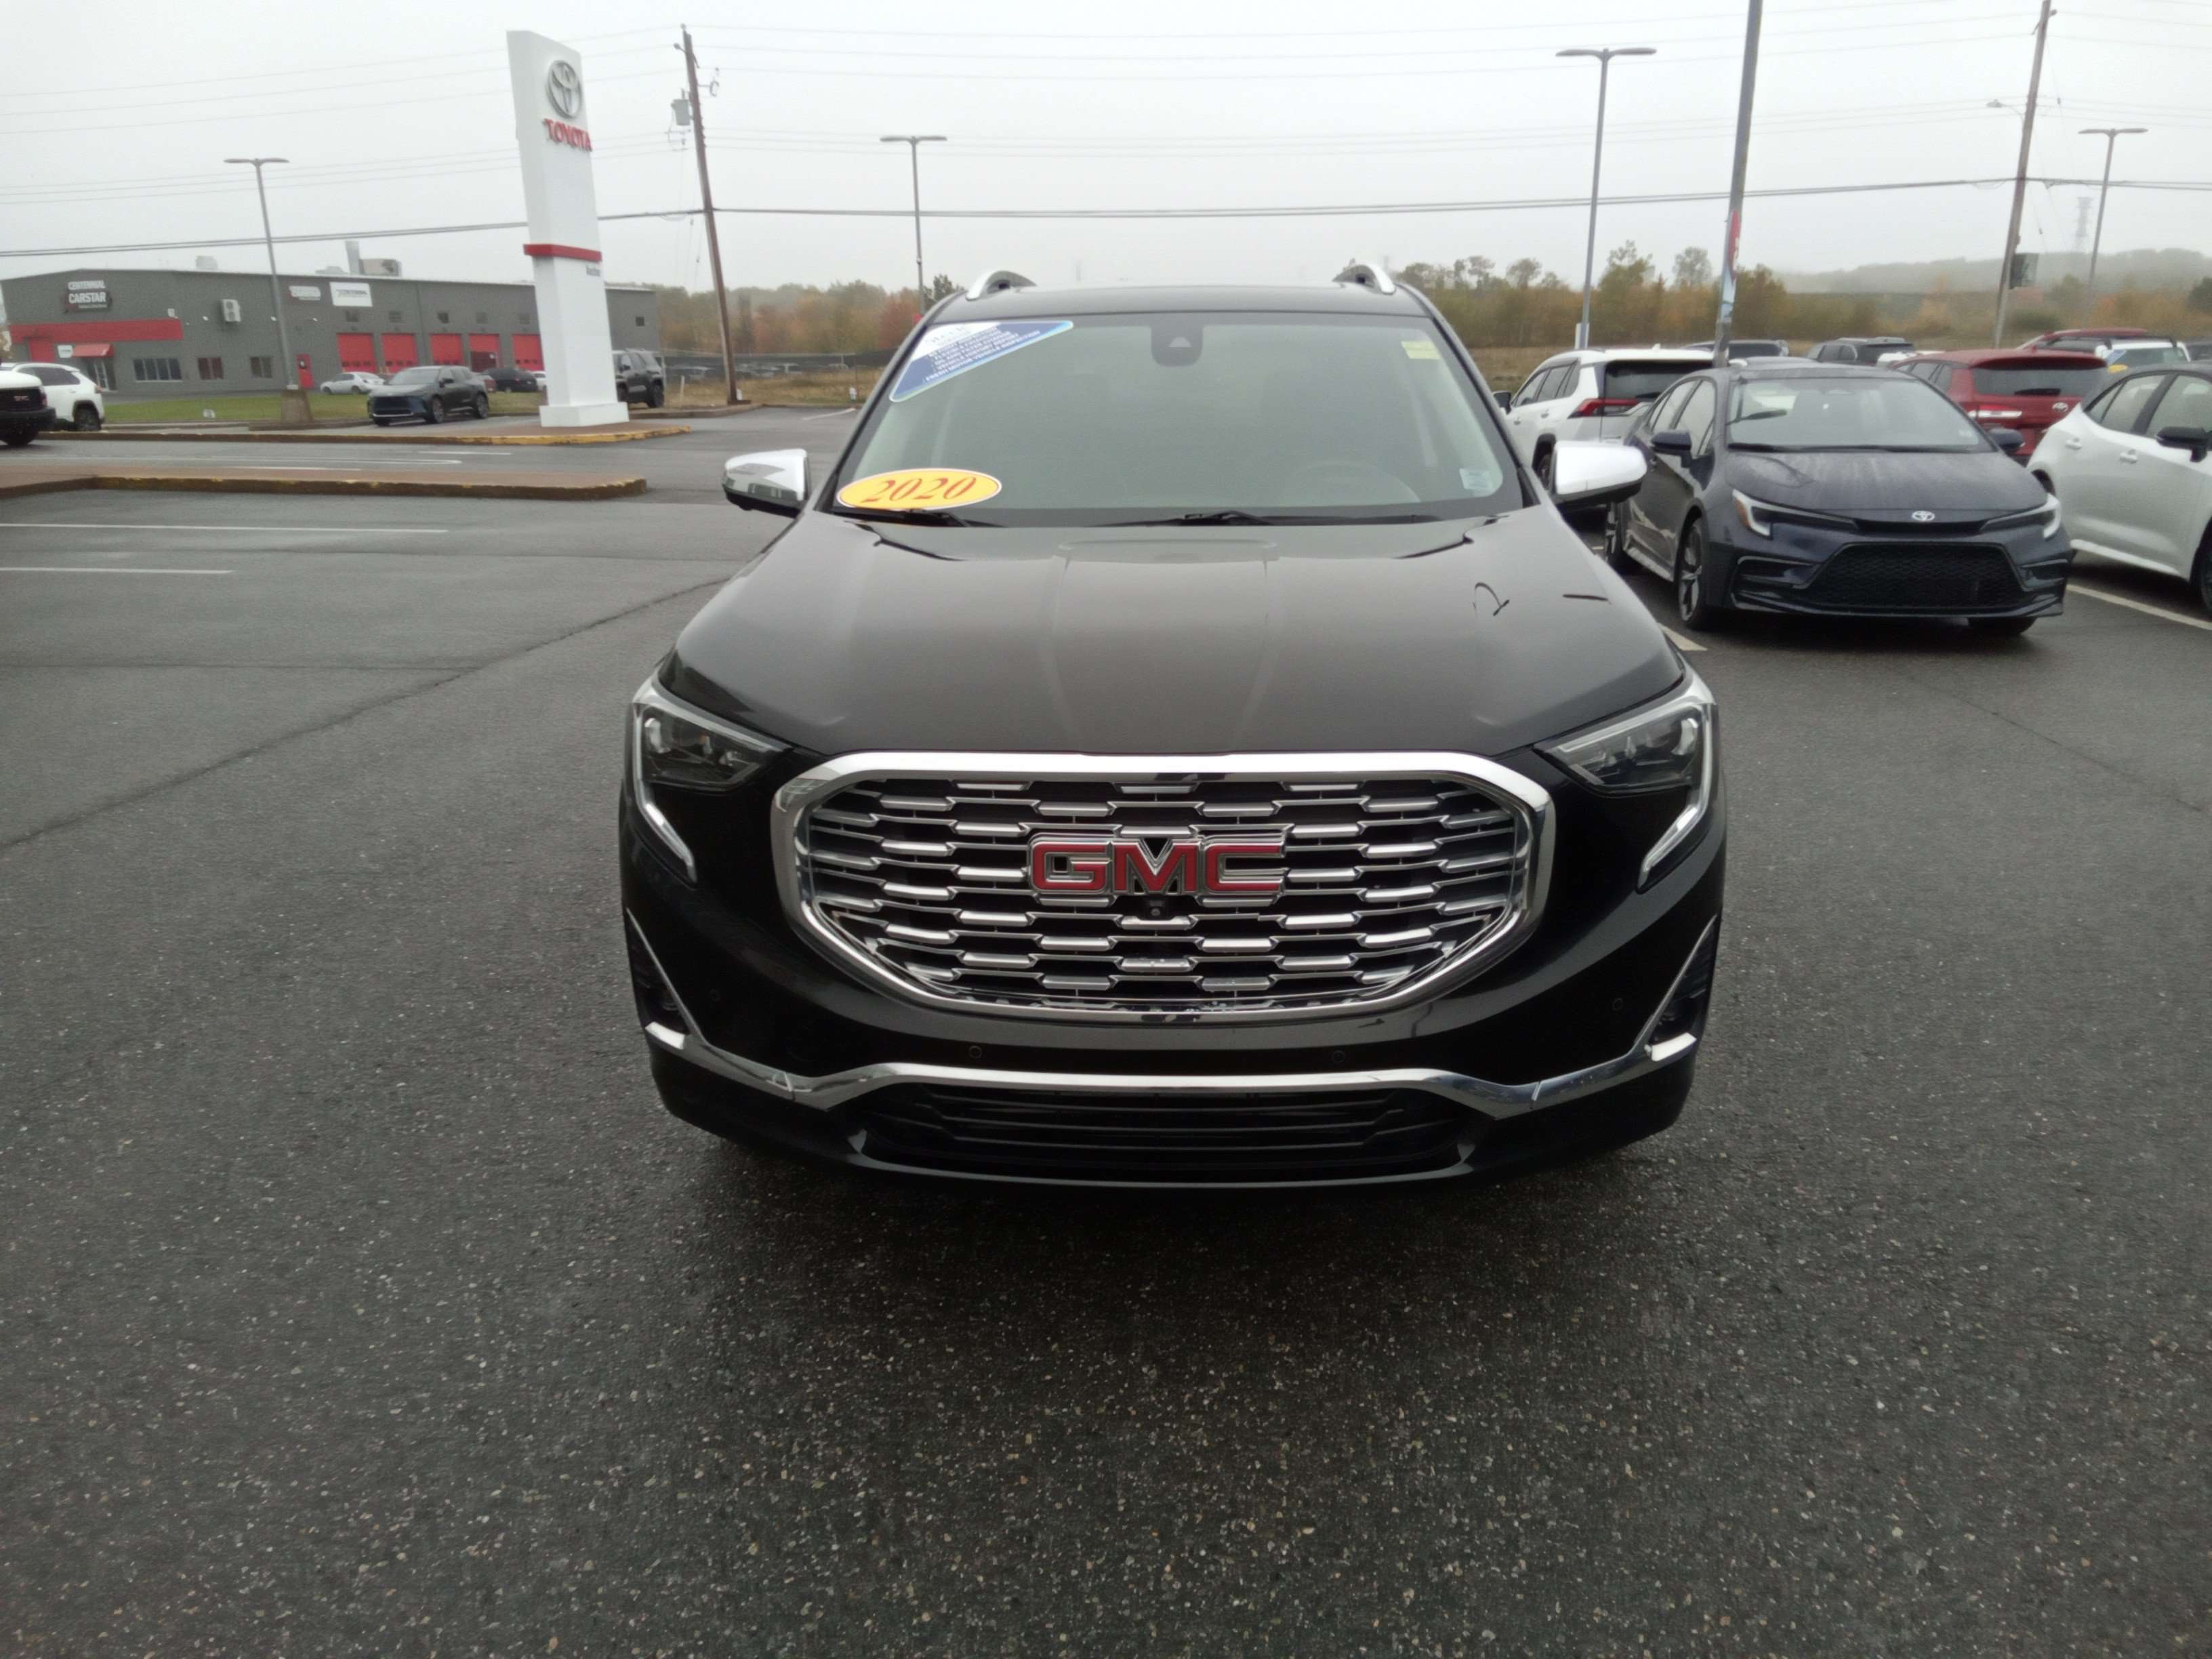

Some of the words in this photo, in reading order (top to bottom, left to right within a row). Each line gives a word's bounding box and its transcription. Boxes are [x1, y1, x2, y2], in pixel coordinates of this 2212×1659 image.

[543, 119, 592, 151] TOYOTA
[69, 292, 106, 304] CARSTAR
[861, 476, 976, 503] 2020
[1029, 834, 1289, 895] GMC
